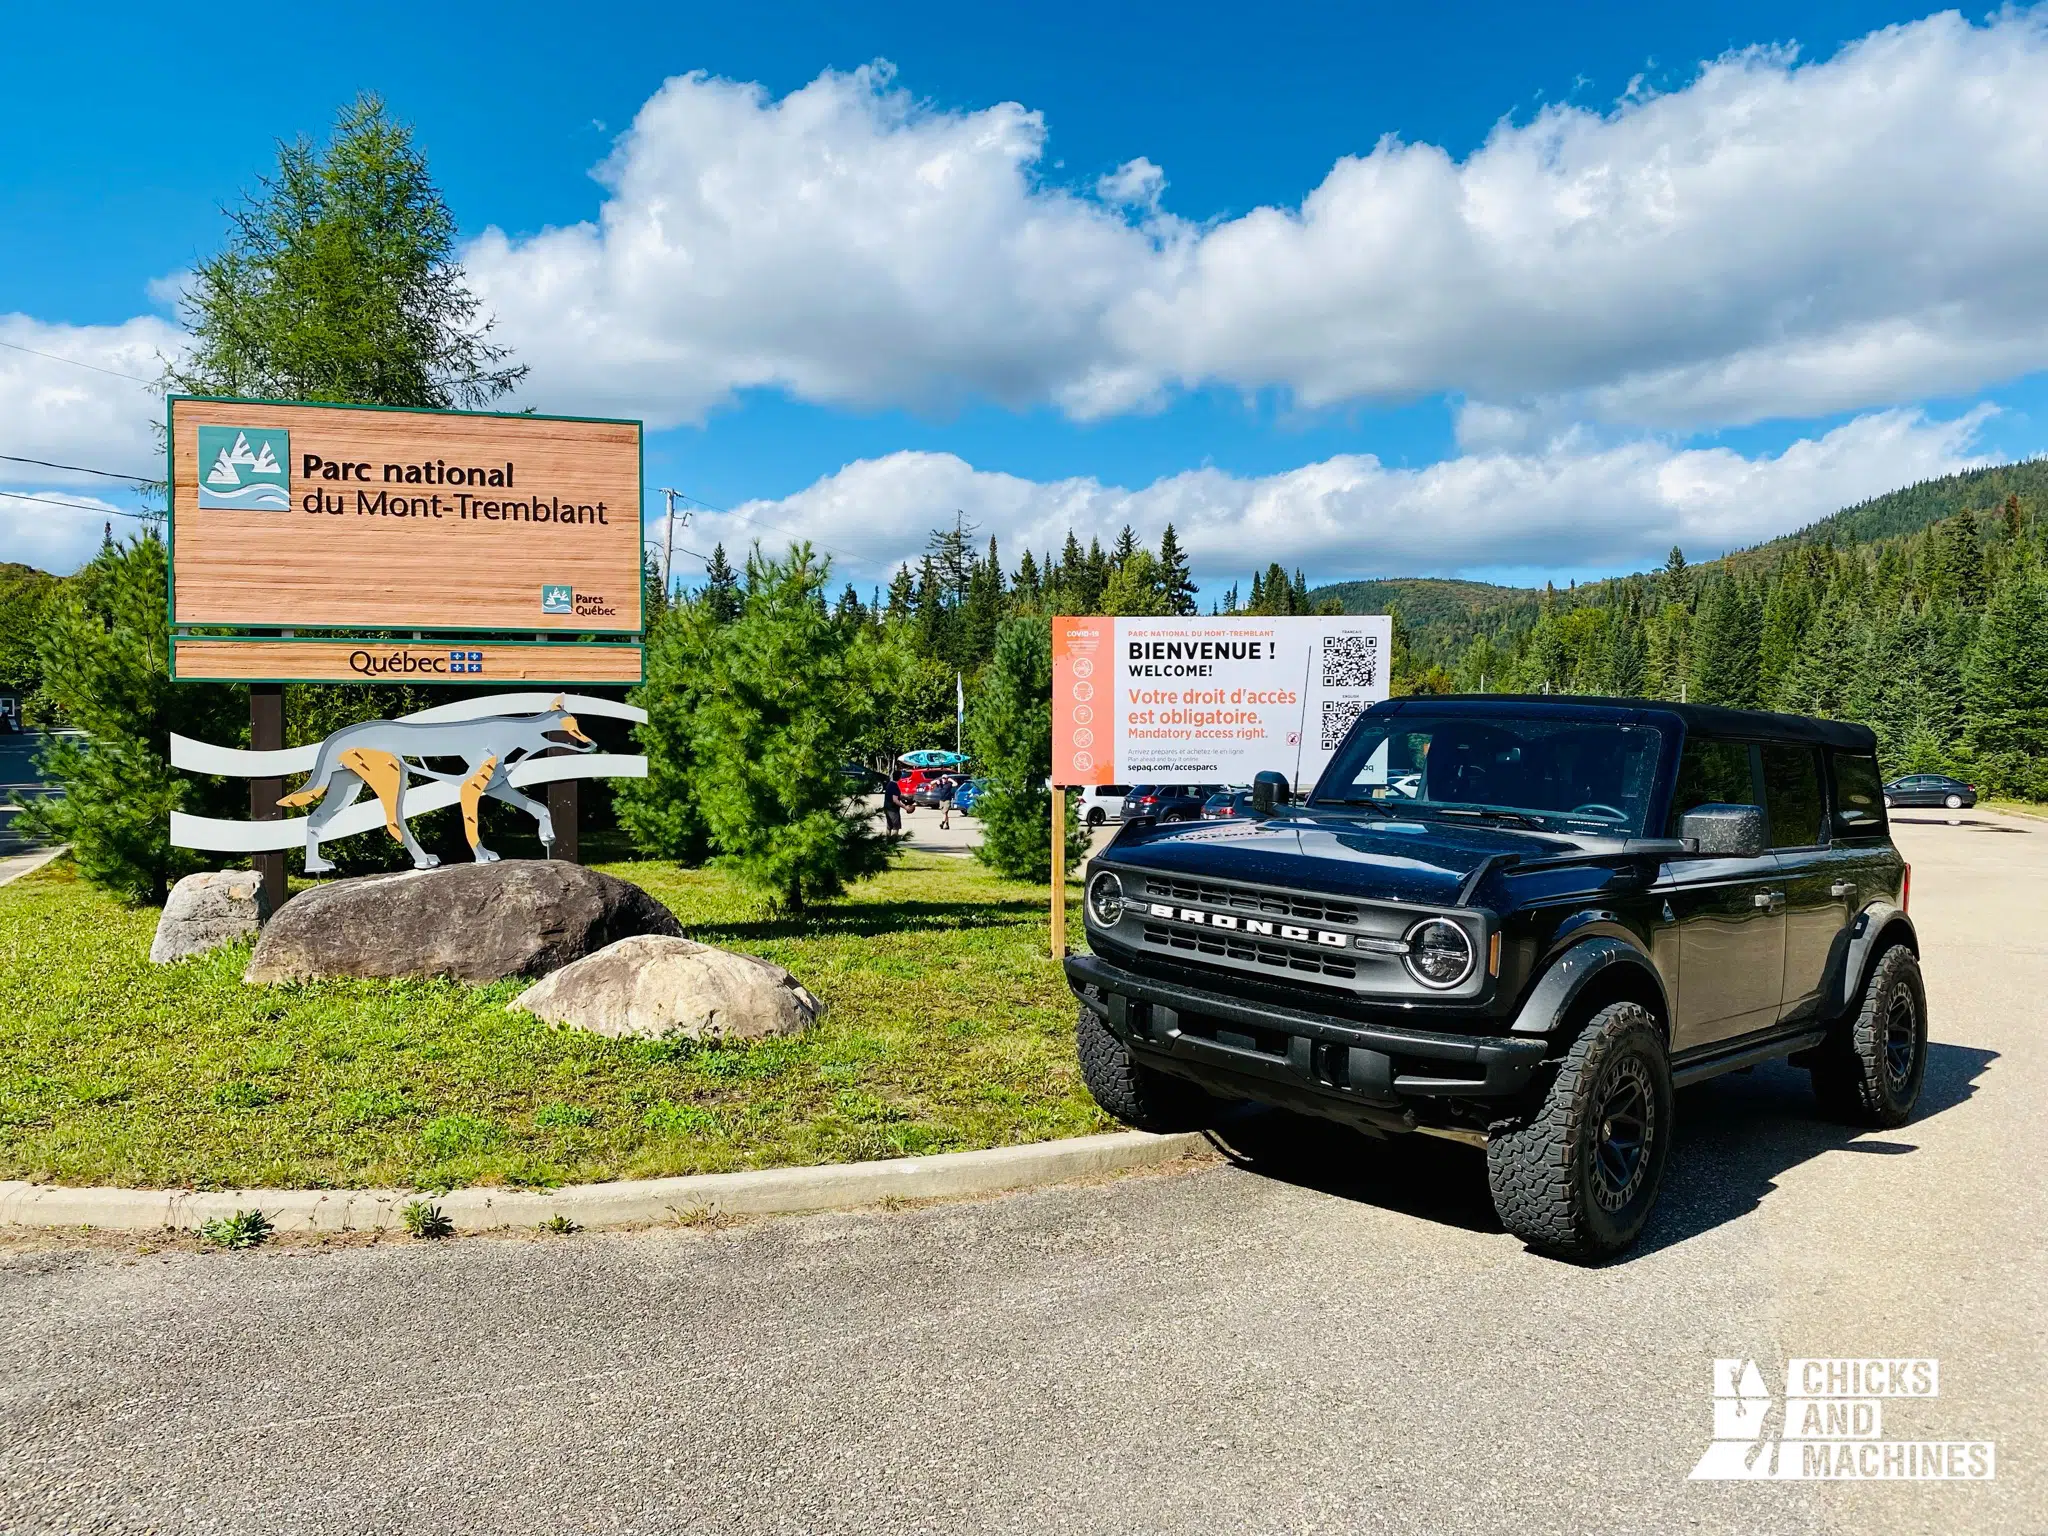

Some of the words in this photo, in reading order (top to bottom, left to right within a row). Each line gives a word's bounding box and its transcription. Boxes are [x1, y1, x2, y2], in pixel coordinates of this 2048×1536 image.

[303, 454, 371, 482] Parc
[383, 460, 514, 488] national
[303, 489, 344, 516] du
[357, 492, 609, 525] Mont-Tremblant
[575, 594, 604, 604] Parcs
[575, 604, 616, 617] Québec
[1066, 630, 1100, 638] COVID-19
[1129, 642, 1262, 660] BIENVENUE
[349, 651, 446, 674] Québec
[1128, 664, 1213, 677] WELCOME!
[1128, 688, 1178, 704] Votre
[1183, 688, 1226, 704] droit
[1230, 688, 1297, 704] d'accès
[1128, 709, 1155, 725] est
[1160, 708, 1263, 727] obligatoire.
[1128, 728, 1192, 741] Mandatory
[1194, 730, 1234, 739] access
[1236, 728, 1268, 741] right.
[1127, 763, 1218, 772] sepaq.com/accesparcs
[1150, 903, 1348, 948] BRONCO
